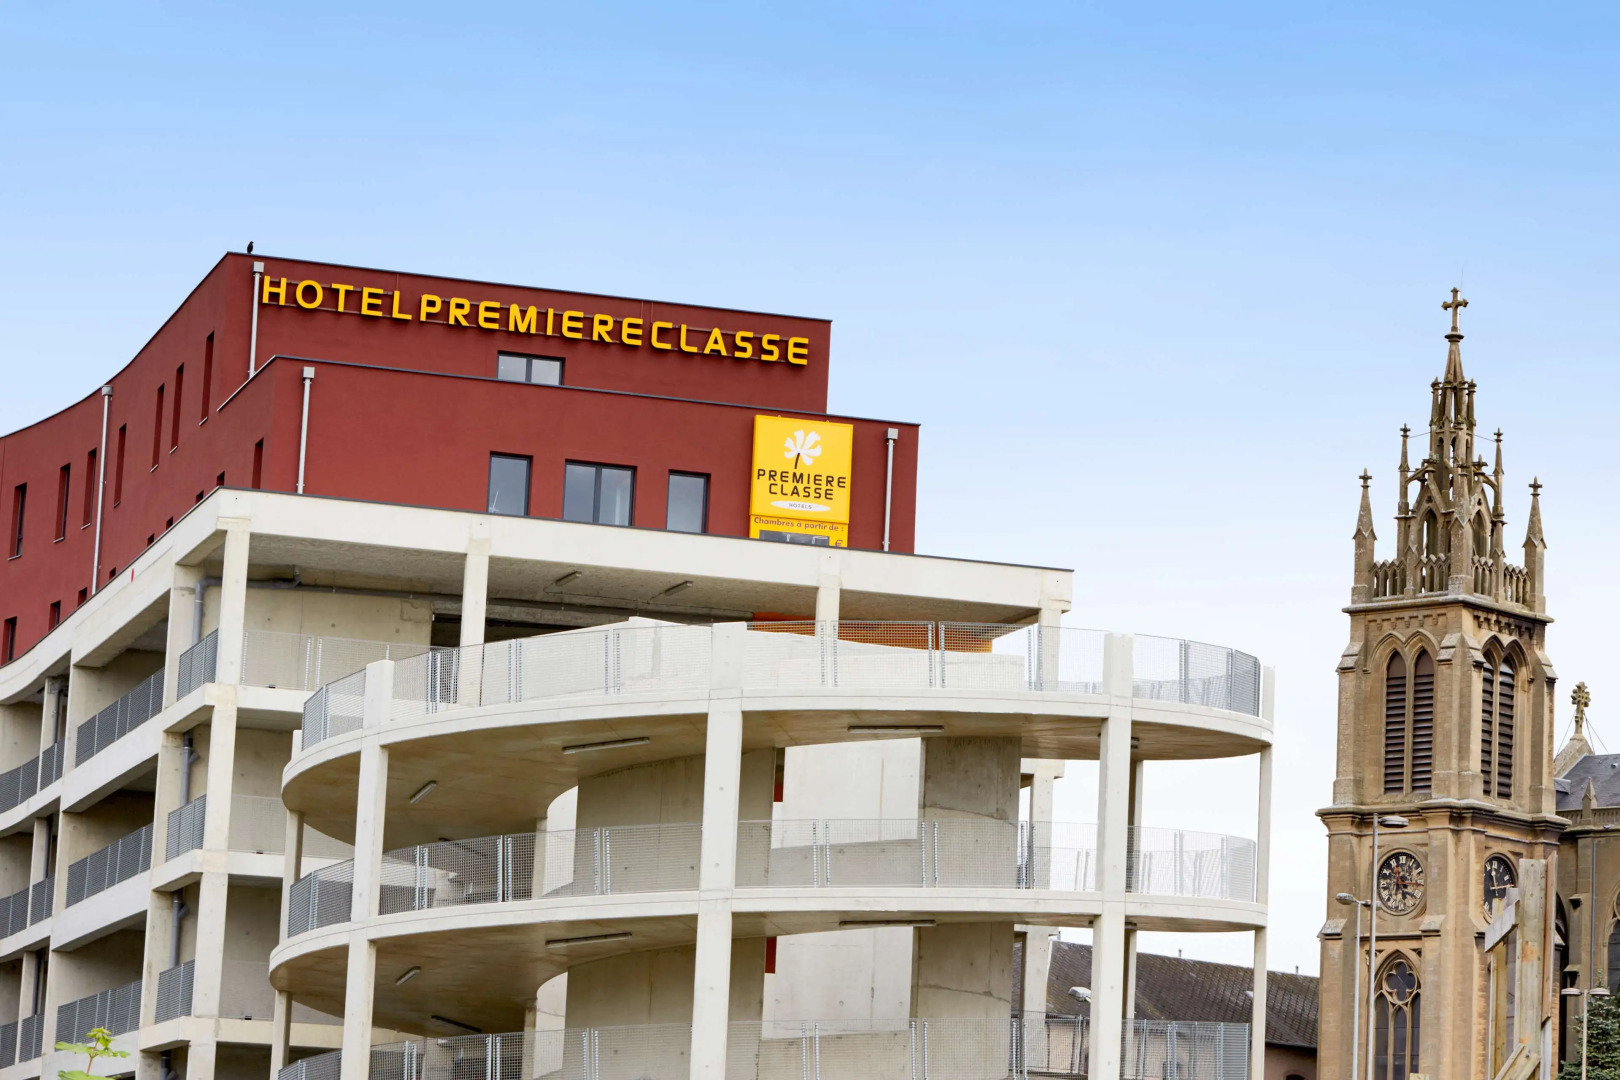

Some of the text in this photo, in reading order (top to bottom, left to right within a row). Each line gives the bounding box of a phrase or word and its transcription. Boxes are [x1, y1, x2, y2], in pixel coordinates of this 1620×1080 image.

[757, 468, 847, 488] PREMIERE
[769, 483, 834, 500] CLASSE
[754, 516, 794, 527] Chambres
